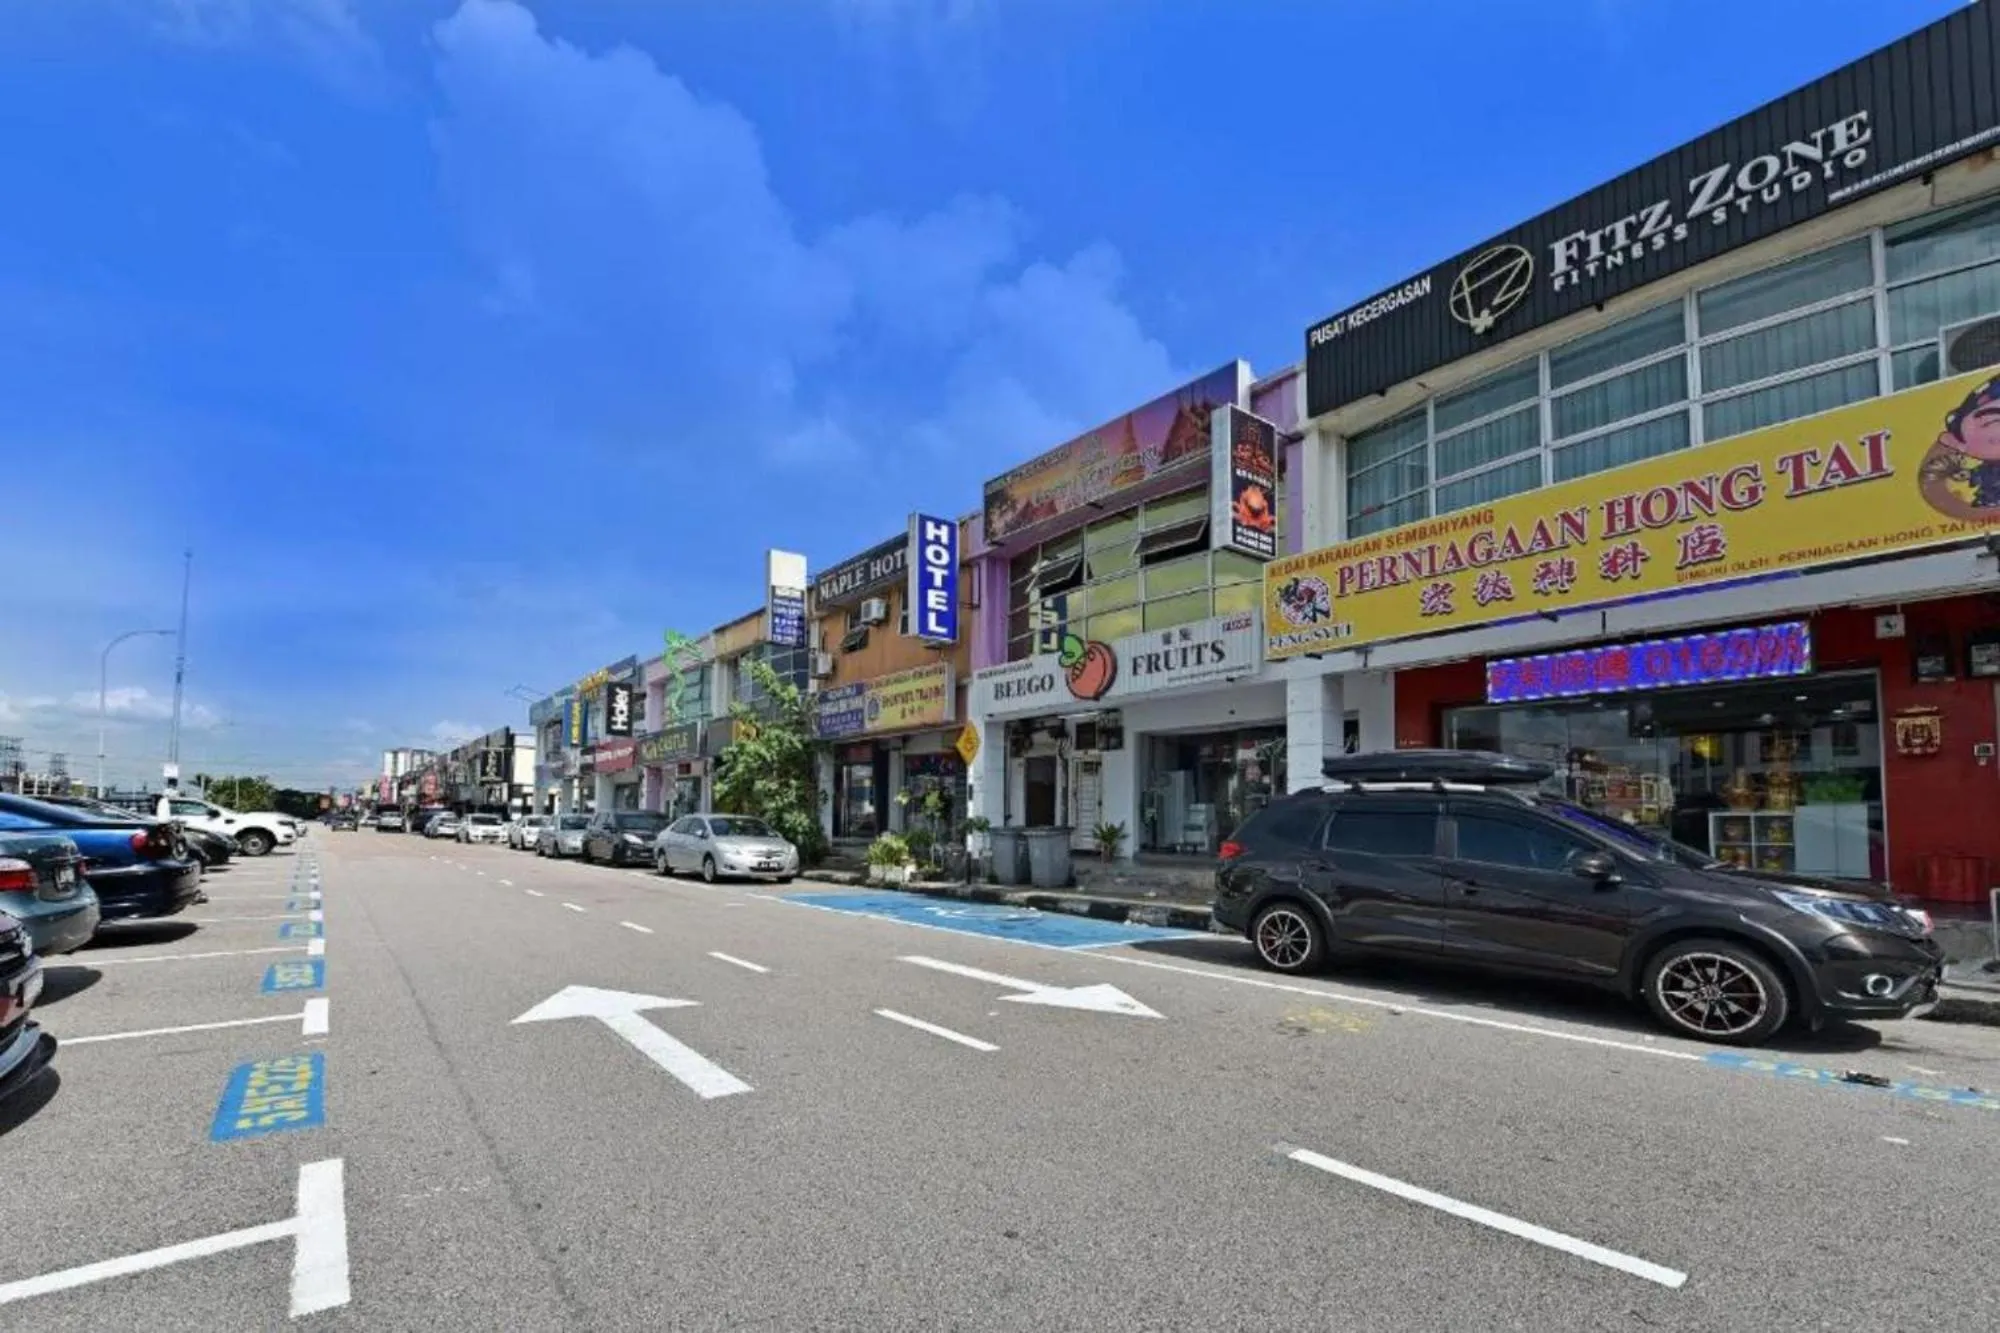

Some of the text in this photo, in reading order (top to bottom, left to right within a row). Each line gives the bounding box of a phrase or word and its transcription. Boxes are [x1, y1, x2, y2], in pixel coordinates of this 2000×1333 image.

[1548, 200, 1673, 277] FITZ
[1686, 110, 1872, 219] ZONE
[1552, 222, 1688, 292] FITNESS
[1711, 147, 1868, 226] STUDIO
[1310, 275, 1432, 347] PUSAT KECERGASAN
[1307, 538, 1382, 568] BARANGAN
[1386, 508, 1495, 546] SEMBAHYANG
[1336, 428, 1894, 598] PERNIAGAAN HONG TAI
[1777, 537, 1879, 564] PERNIAGAAN
[1883, 525, 1934, 546] HONG
[1941, 520, 1965, 535] TAI
[819, 566, 865, 603] MAPLE
[869, 547, 908, 581] HOT
[925, 520, 950, 635] HOTEL
[993, 673, 1055, 701] BEEGO
[1131, 639, 1226, 677] FRUITS
